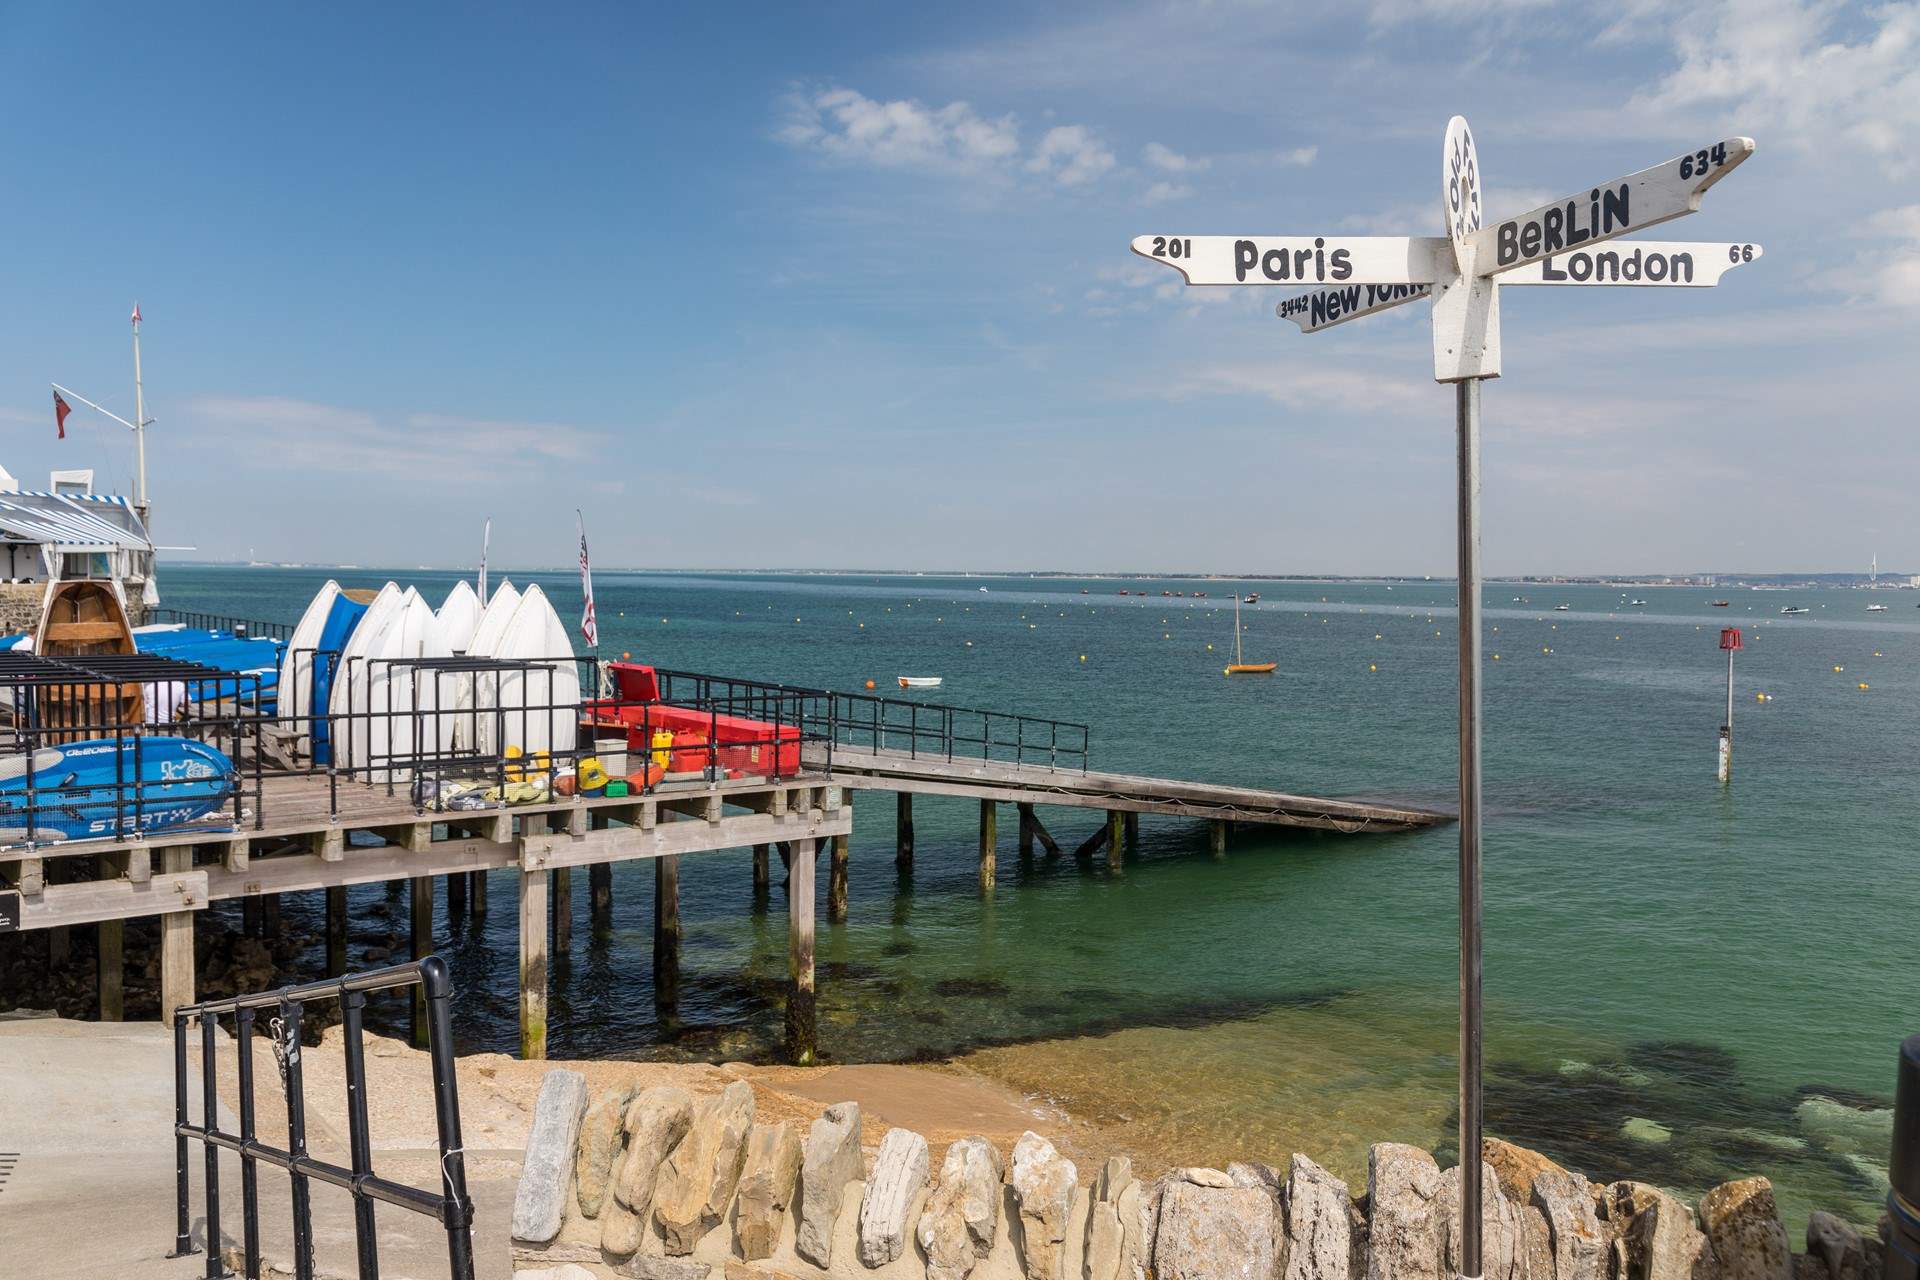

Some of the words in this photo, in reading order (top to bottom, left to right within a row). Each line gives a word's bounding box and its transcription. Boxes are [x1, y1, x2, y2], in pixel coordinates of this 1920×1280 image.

[1679, 141, 1727, 181] 634
[1152, 236, 1191, 259] 201
[1234, 237, 1353, 282] Paris
[1542, 247, 1694, 283] London
[1729, 244, 1753, 264] 66
[1280, 294, 1309, 319] 3442
